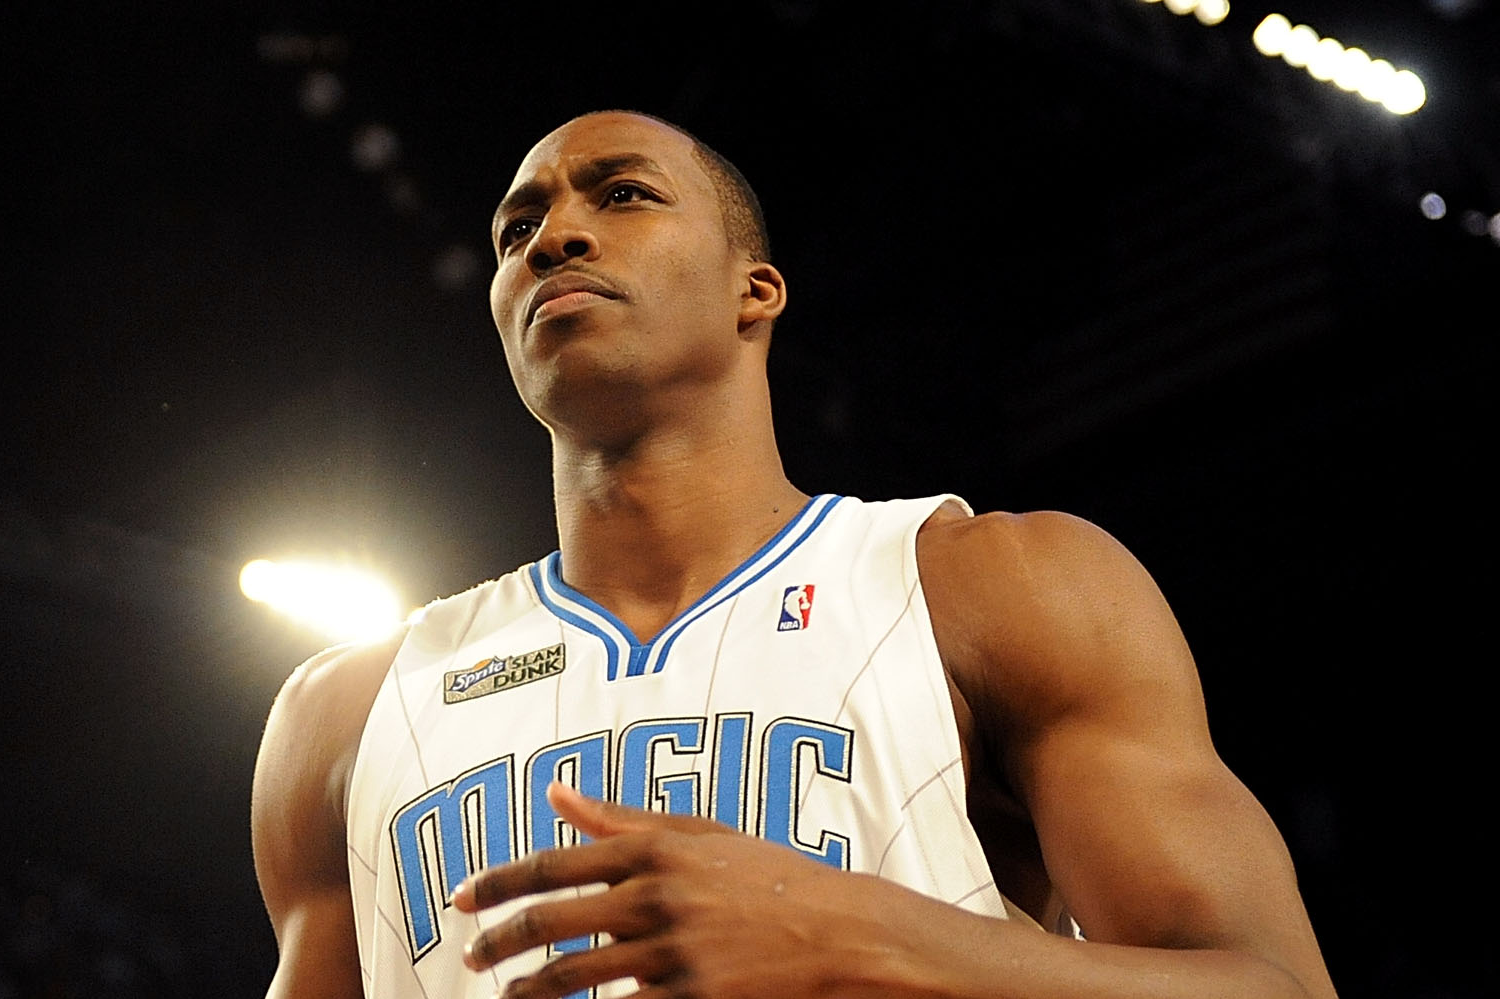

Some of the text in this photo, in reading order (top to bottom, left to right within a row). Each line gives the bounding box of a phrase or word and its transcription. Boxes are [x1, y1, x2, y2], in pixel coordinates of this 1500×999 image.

[780, 620, 799, 630] NBA
[493, 657, 561, 689] DUNK
[510, 645, 561, 670] SLAM
[451, 660, 504, 691] Sprite
[389, 711, 855, 966] MAGIC
